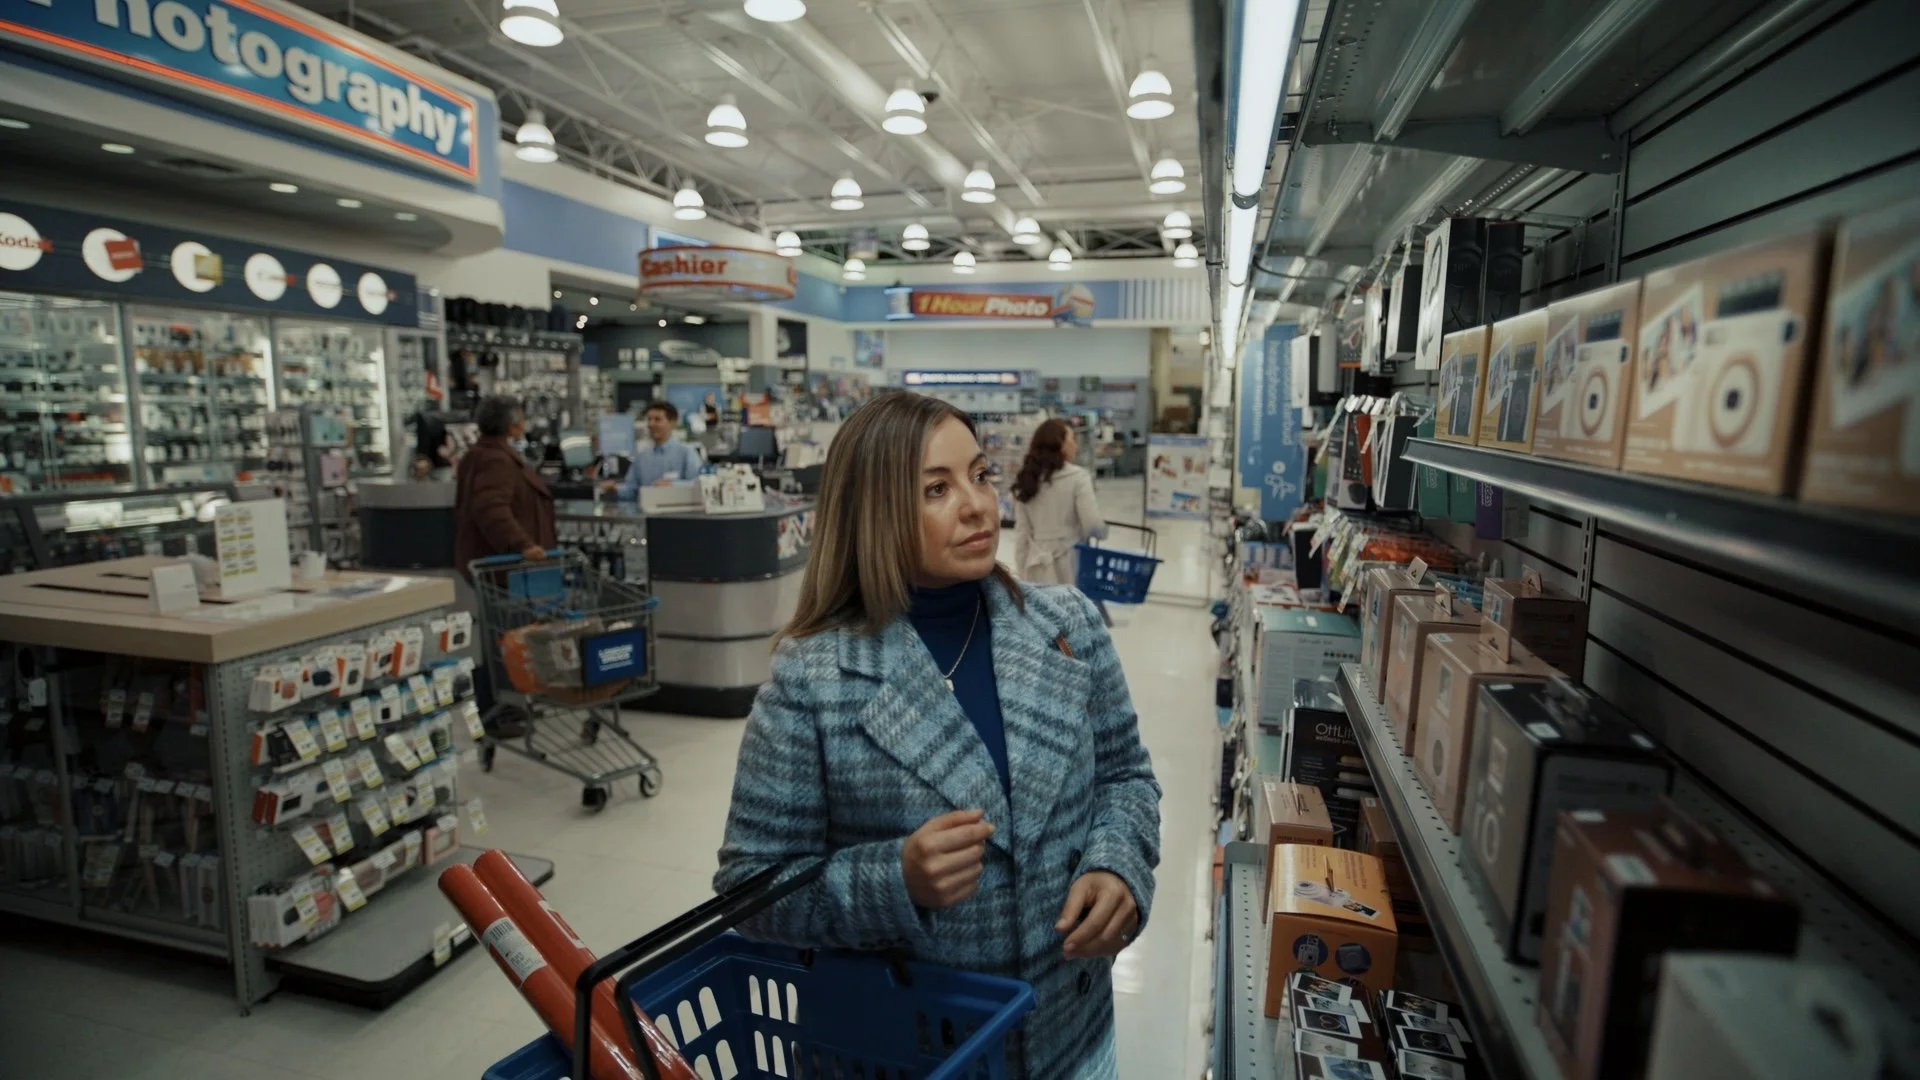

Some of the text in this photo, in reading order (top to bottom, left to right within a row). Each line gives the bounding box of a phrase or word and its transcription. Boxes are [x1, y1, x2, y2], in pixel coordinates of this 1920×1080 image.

[28, 0, 457, 156] otography
[640, 253, 729, 277] Cashier
[930, 294, 985, 314] Hour
[984, 297, 1049, 316] Photo
